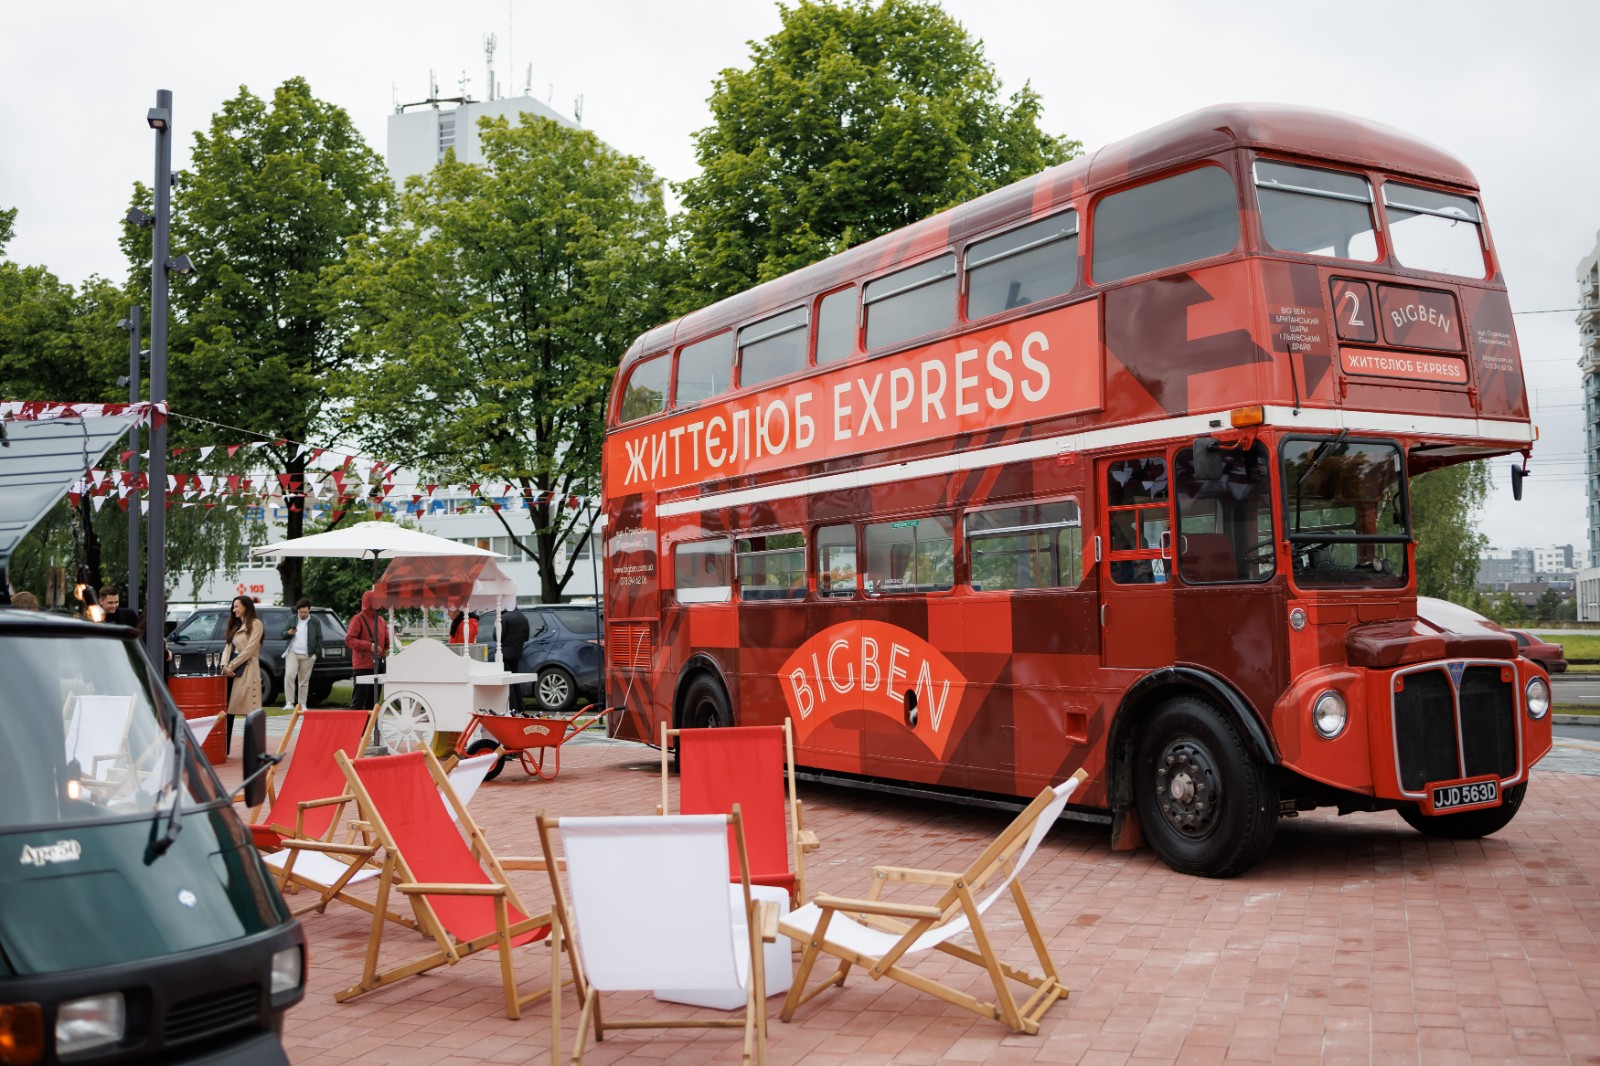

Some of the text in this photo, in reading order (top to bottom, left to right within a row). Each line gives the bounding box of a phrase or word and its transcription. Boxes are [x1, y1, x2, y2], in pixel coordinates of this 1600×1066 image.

[1345, 291, 1364, 326] 2
[1391, 304, 1450, 333] BIGBEN
[1348, 355, 1460, 377] ЖИТТЄЛЮБ EXPRESS
[624, 331, 1051, 486] ЖИТТЄЛЮБ EXPRESS
[249, 584, 265, 593] 103
[790, 636, 950, 733] BIGBEN
[1435, 783, 1495, 807] JJD 563D
